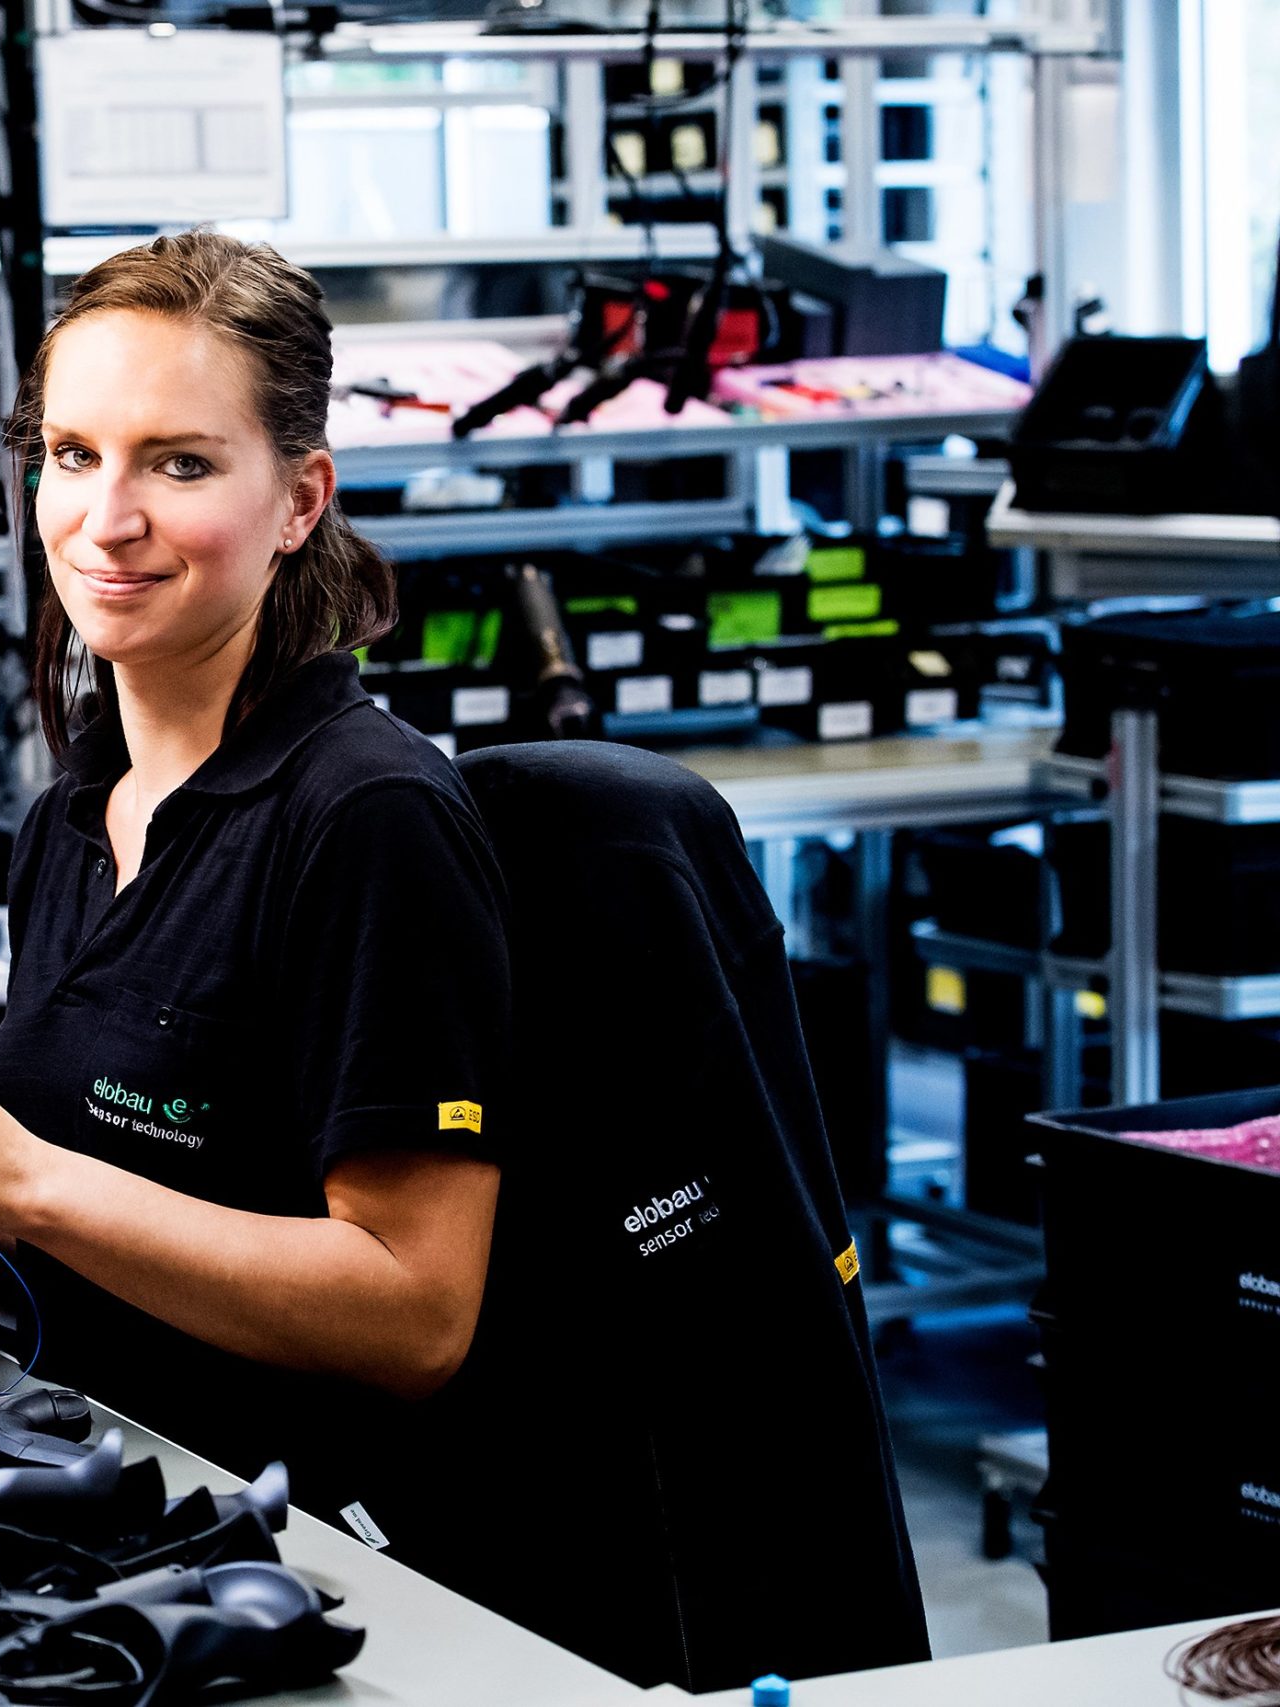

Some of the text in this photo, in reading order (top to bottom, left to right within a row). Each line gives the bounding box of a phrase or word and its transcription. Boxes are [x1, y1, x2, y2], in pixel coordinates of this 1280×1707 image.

[93, 1076, 153, 1115] elobau
[88, 1102, 205, 1149] sensor technology
[469, 1109, 480, 1123] ESD
[623, 1180, 705, 1233] elobau
[639, 1217, 694, 1257] sensor
